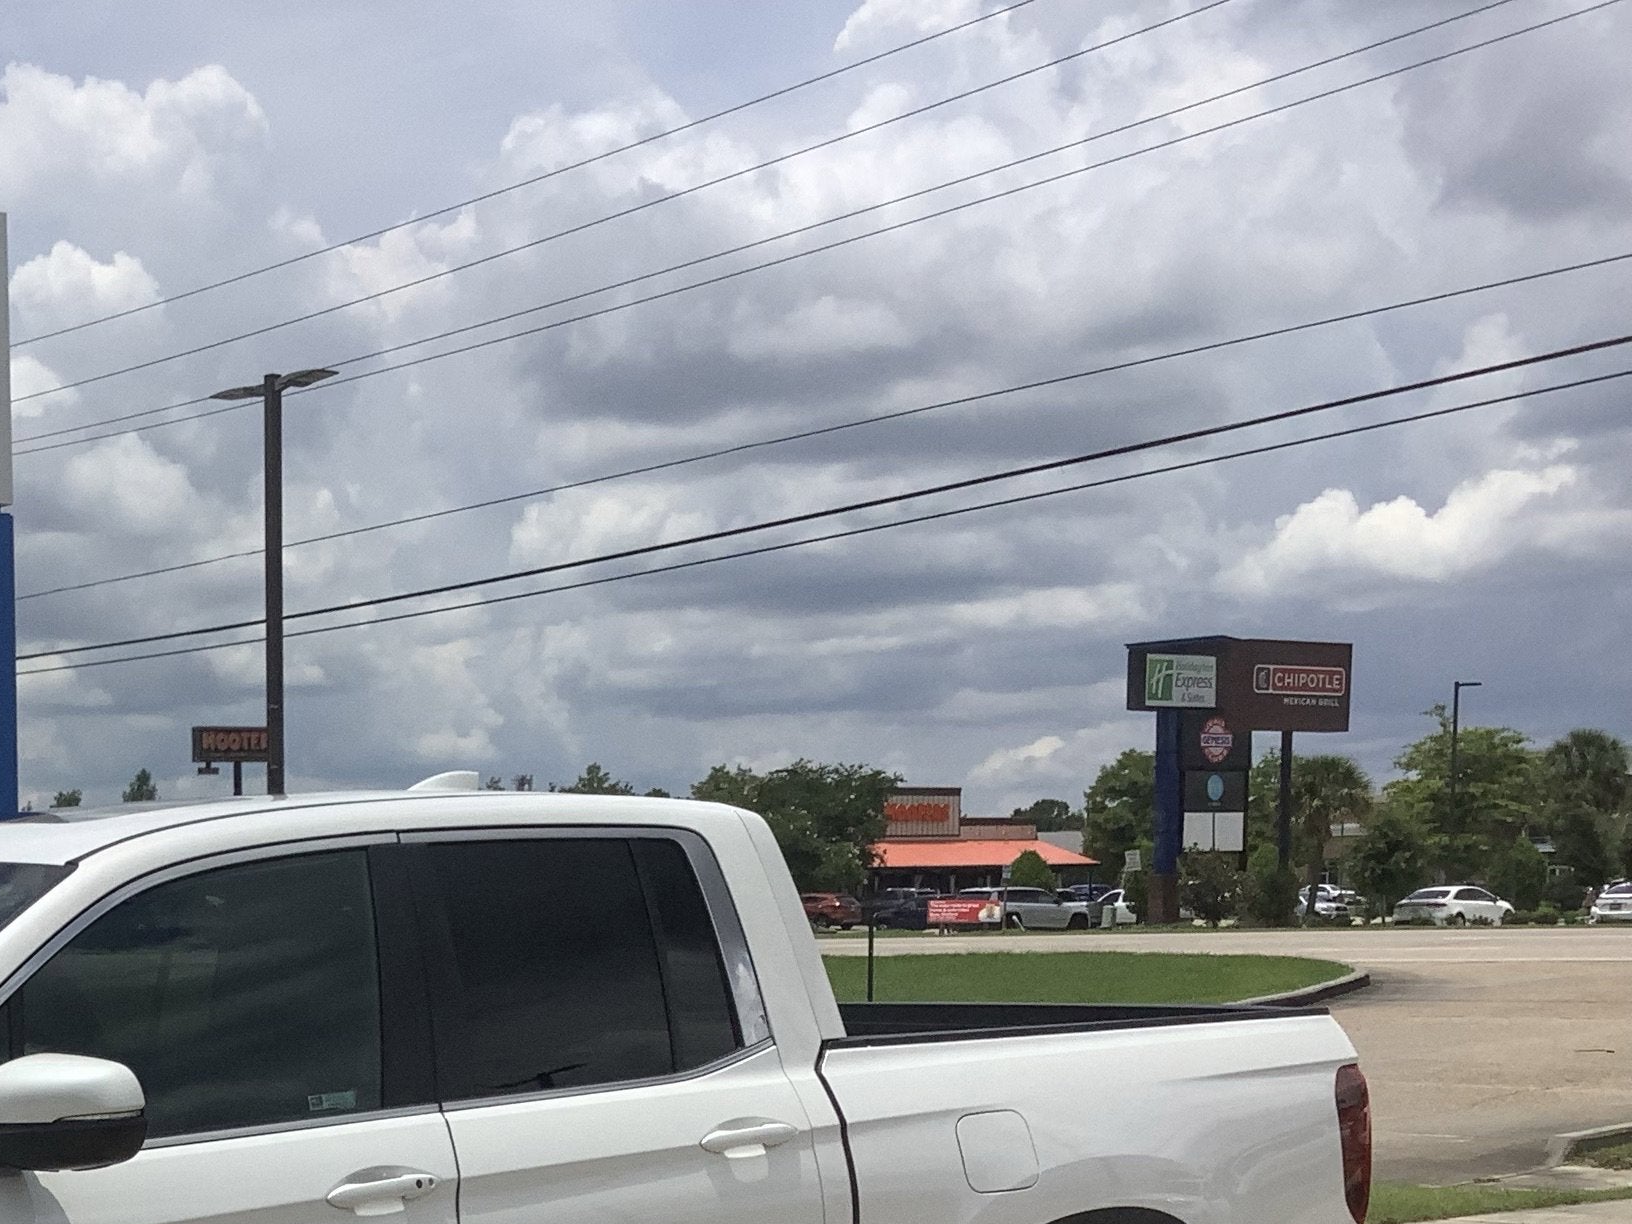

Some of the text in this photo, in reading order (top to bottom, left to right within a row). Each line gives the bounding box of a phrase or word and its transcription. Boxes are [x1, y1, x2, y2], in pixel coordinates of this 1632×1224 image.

[1175, 672, 1213, 691] Express
[1274, 673, 1341, 688] CHIPOTLE
[1283, 697, 1316, 706] MEXICAN
